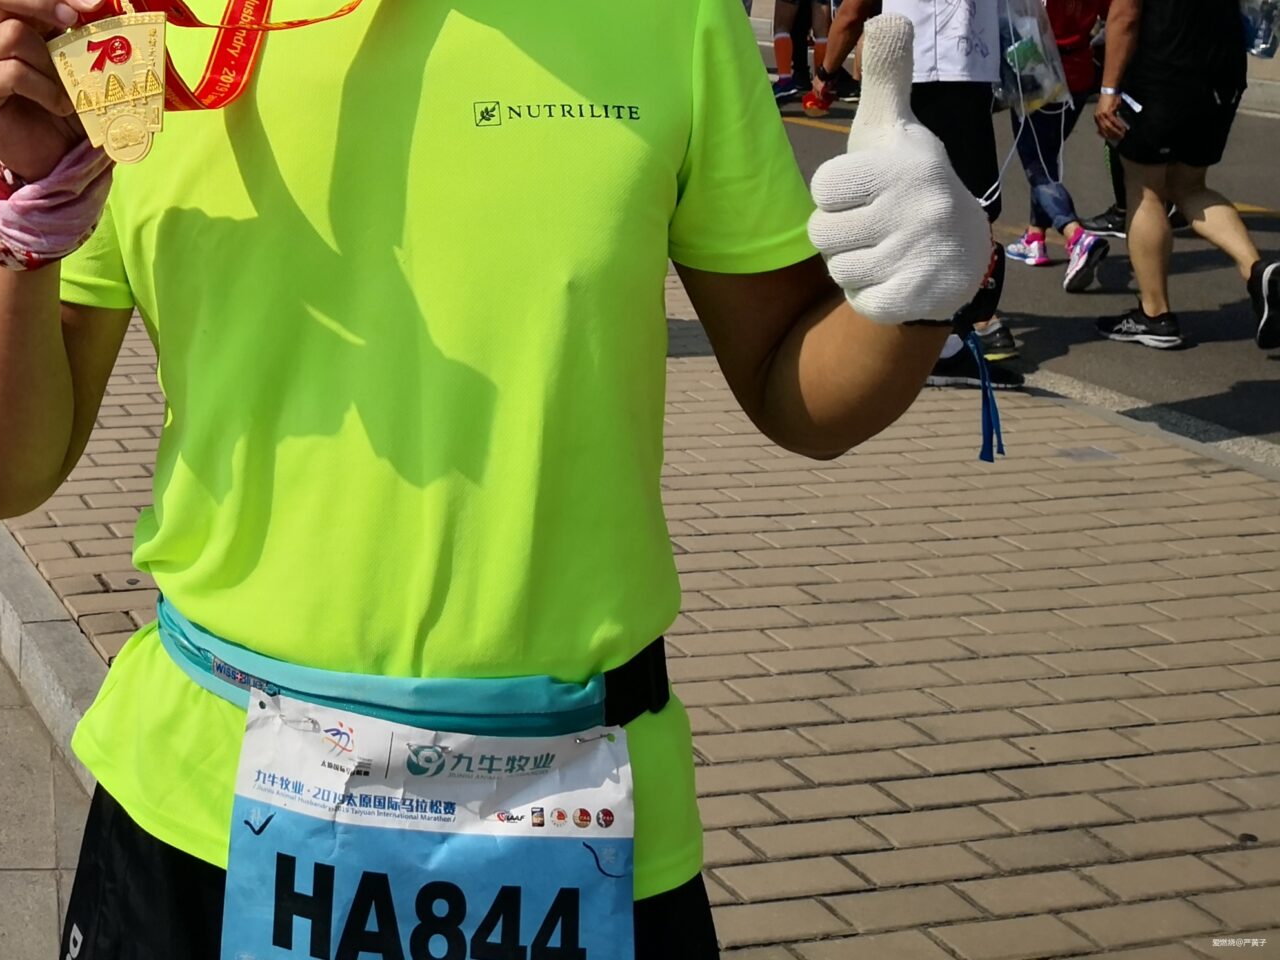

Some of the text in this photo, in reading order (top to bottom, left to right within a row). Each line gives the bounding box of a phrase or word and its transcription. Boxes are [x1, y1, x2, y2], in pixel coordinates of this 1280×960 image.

[508, 104, 641, 121] NUTRILITE
[450, 752, 555, 775] 九牛牧业
[351, 807, 376, 817] Taiyuan
[376, 810, 419, 820] International
[420, 814, 453, 823] Marathon
[272, 852, 587, 960] HA844
